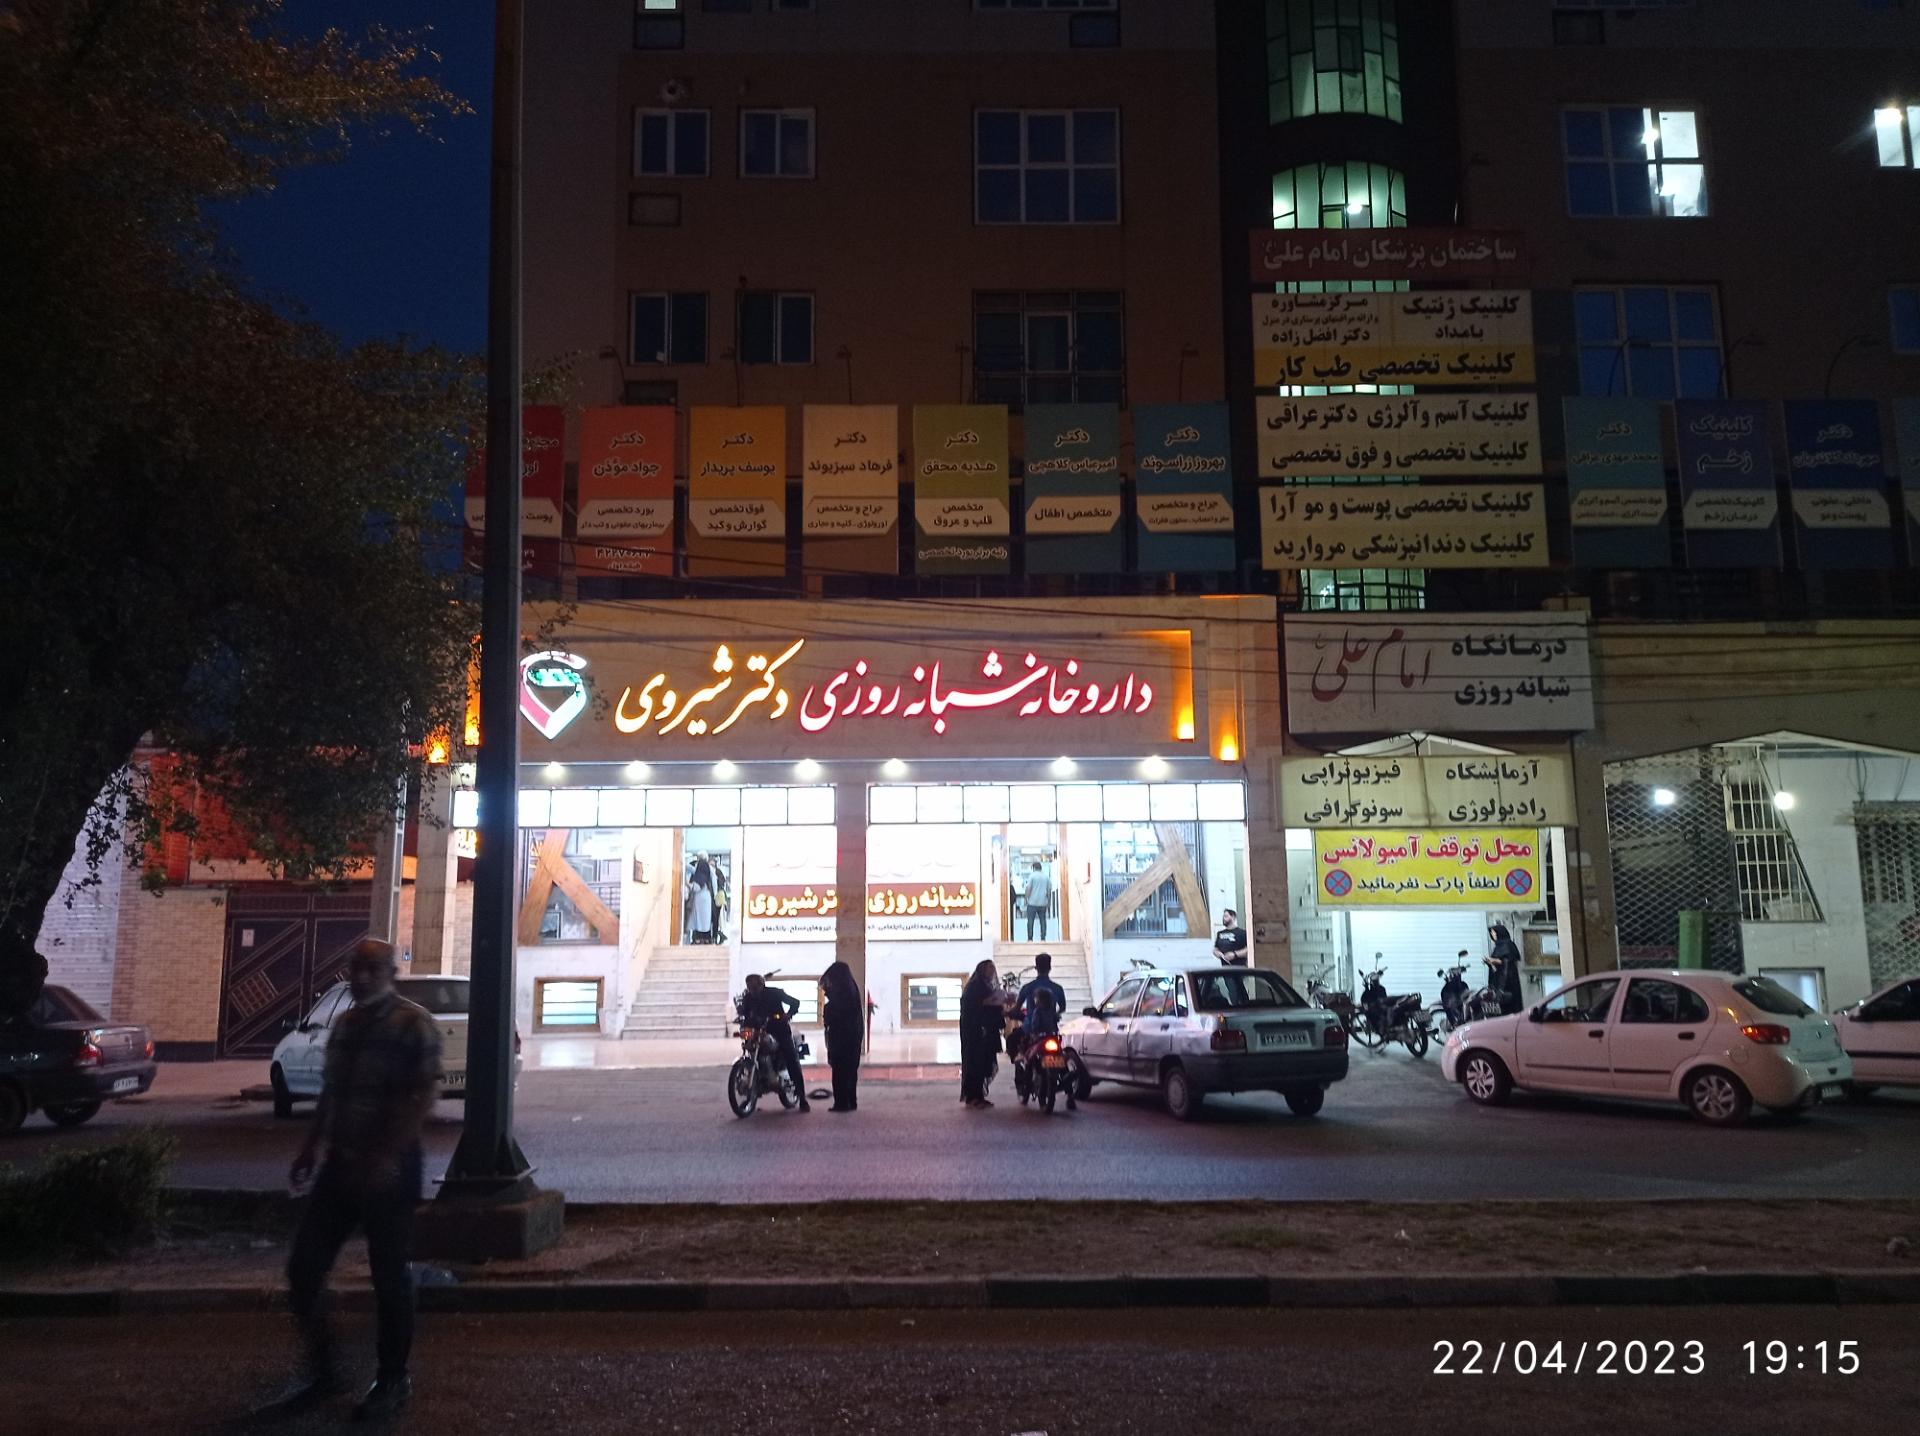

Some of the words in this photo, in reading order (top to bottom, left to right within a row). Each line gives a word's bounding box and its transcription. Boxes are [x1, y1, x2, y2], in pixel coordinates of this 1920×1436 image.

[1308, 239, 1348, 268] امام
[1353, 238, 1426, 269] پزشکان
[1430, 237, 1517, 269] ساختمان
[1271, 295, 1327, 313] مشاوره
[1403, 297, 1457, 319] ژنتیک
[1460, 295, 1520, 319] کلینیک
[1271, 328, 1300, 347] زاده
[1303, 328, 1337, 346] افضل
[1341, 328, 1370, 345] دکتر
[1435, 323, 1484, 340] بامداد
[1276, 356, 1306, 384] کار
[1313, 354, 1352, 383] طب
[1358, 353, 1441, 383] تخصصی
[1447, 352, 1516, 380] کلینیک
[1266, 402, 1318, 430] عراقی
[1320, 403, 1358, 430] دکتر
[1435, 400, 1470, 428] آسم
[1472, 401, 1530, 427] کلینیک
[609, 431, 645, 449] دکتر
[722, 432, 755, 448] دکتر
[834, 431, 867, 448] دکتر
[946, 431, 980, 448] دکتر
[1054, 429, 1091, 447] دکتر
[1164, 427, 1200, 446] دکتر
[1596, 422, 1632, 440] دکتر
[1690, 415, 1754, 441] کلینیک
[858, 458, 893, 475] فرهاد
[1194, 456, 1226, 472] بهروز
[1271, 442, 1342, 469] تخصصی
[1345, 441, 1379, 469] فوق
[1383, 449, 1392, 469] و
[1396, 442, 1467, 469] تخصصی
[1470, 441, 1529, 467] کلینیک
[1696, 447, 1753, 473] زخم
[632, 460, 661, 477] جواد
[739, 459, 776, 477] یوسف
[961, 461, 998, 474] هدیه
[709, 504, 746, 516] تخصص
[747, 504, 765, 516] فوق
[942, 503, 984, 514] متخصص
[1034, 508, 1065, 520] اطفال
[1067, 510, 1113, 521] متخصص
[1270, 492, 1298, 522] آرا
[1304, 497, 1324, 521] مو
[1330, 501, 1338, 520] و
[1342, 495, 1391, 521] پوست
[1395, 492, 1468, 519] تخصصی
[1471, 492, 1533, 518] کلینیک
[733, 520, 767, 532] گوارش
[973, 515, 993, 527] قلب
[1273, 535, 1346, 562] مروارید
[1351, 534, 1467, 562] دندانپزشکی
[1470, 532, 1535, 560] کلینیک
[1451, 634, 1568, 663] درمانگاه
[1373, 627, 1432, 714] امام
[613, 643, 734, 737] شیروی
[711, 637, 805, 735] دکتر
[799, 660, 901, 734] روزی
[902, 650, 1050, 735] شبانه
[1019, 652, 1154, 717] داروخانه
[1454, 680, 1513, 706] روزی
[1516, 675, 1571, 704] شبانه
[1301, 759, 1402, 787] فیزیوتراپی
[1446, 758, 1542, 787] آزمایشگاه
[1303, 797, 1404, 824] سونوگرافی
[1448, 797, 1548, 824] رادیولوژی
[1322, 835, 1421, 866] آمبولانس
[1426, 836, 1481, 866] توقف
[1484, 836, 1533, 864] محل
[1357, 876, 1420, 895] نفرمائید
[1424, 876, 1466, 895] پارک
[748, 885, 818, 917] شیروی
[867, 887, 919, 915] روزی
[918, 883, 975, 915] شبانه
